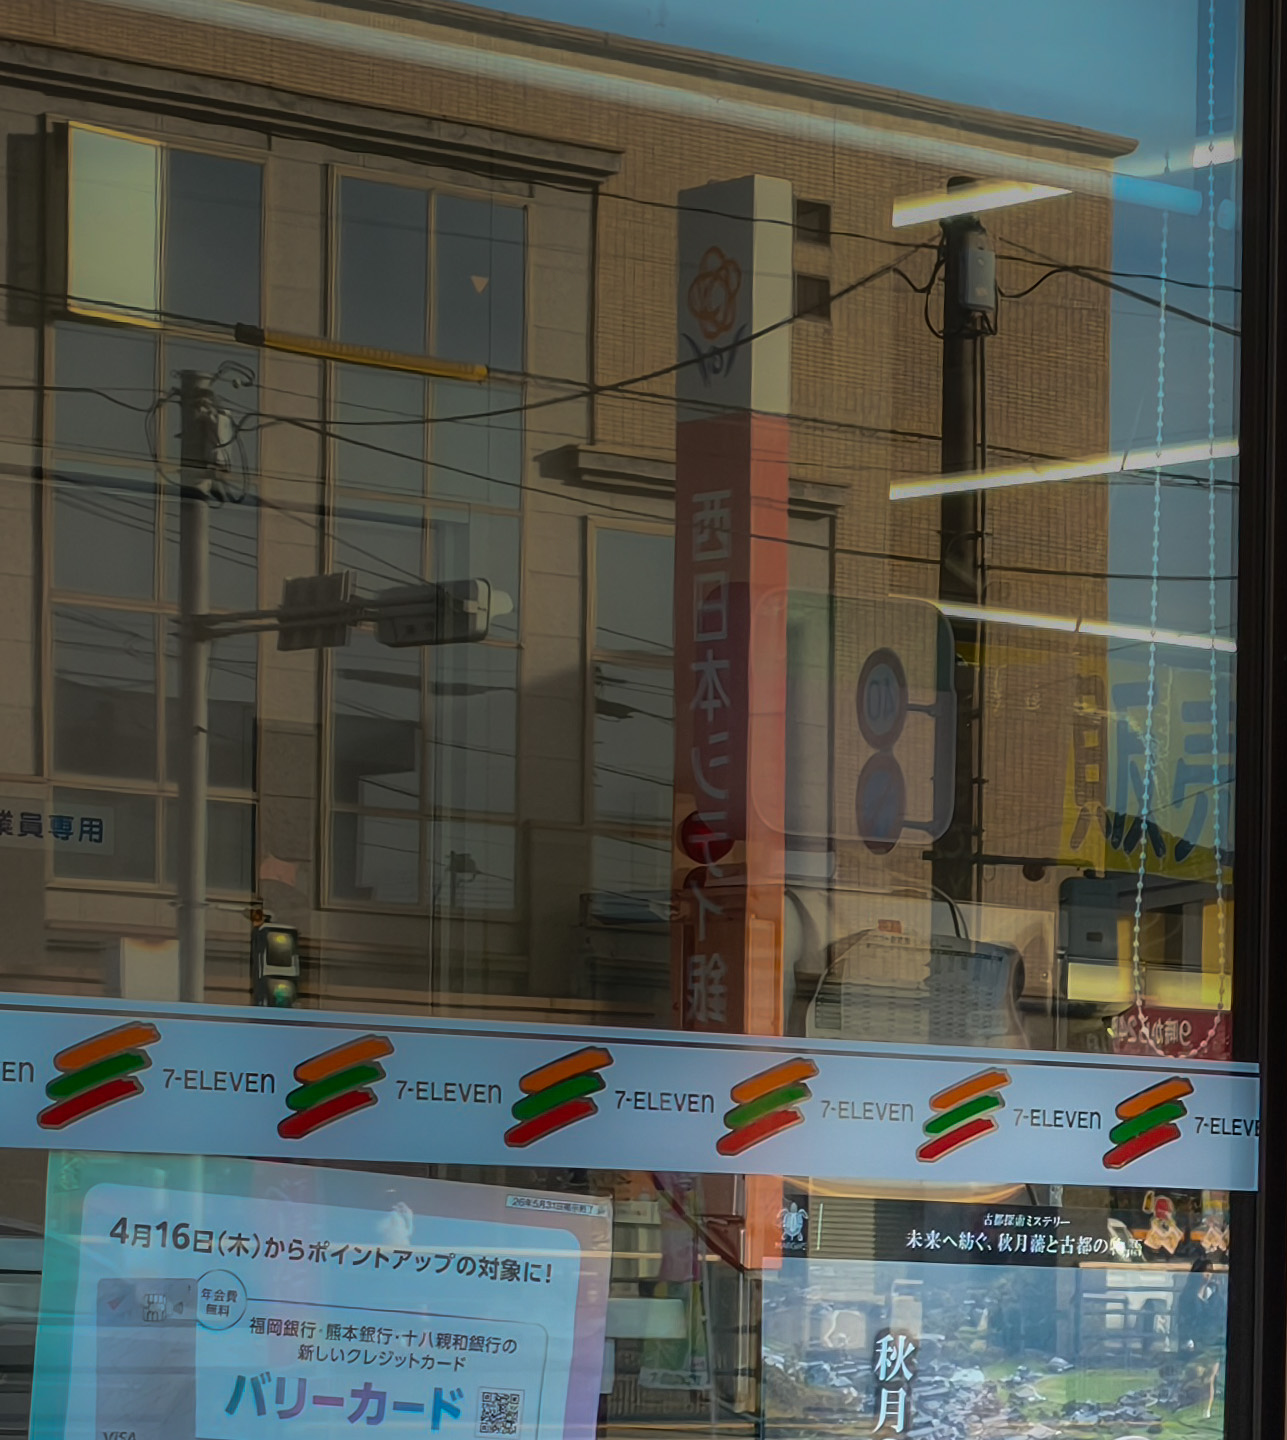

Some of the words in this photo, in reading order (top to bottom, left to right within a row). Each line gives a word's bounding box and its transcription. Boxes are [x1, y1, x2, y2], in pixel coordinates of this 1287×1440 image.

[109, 1216, 554, 1285] 4月16日(木)からポイントアップの対象に!
[201, 1286, 239, 1303] 年会費
[206, 1303, 231, 1318] 無料
[298, 1344, 467, 1371] 新しいクレジットカード
[225, 1371, 465, 1431] バリーカード
